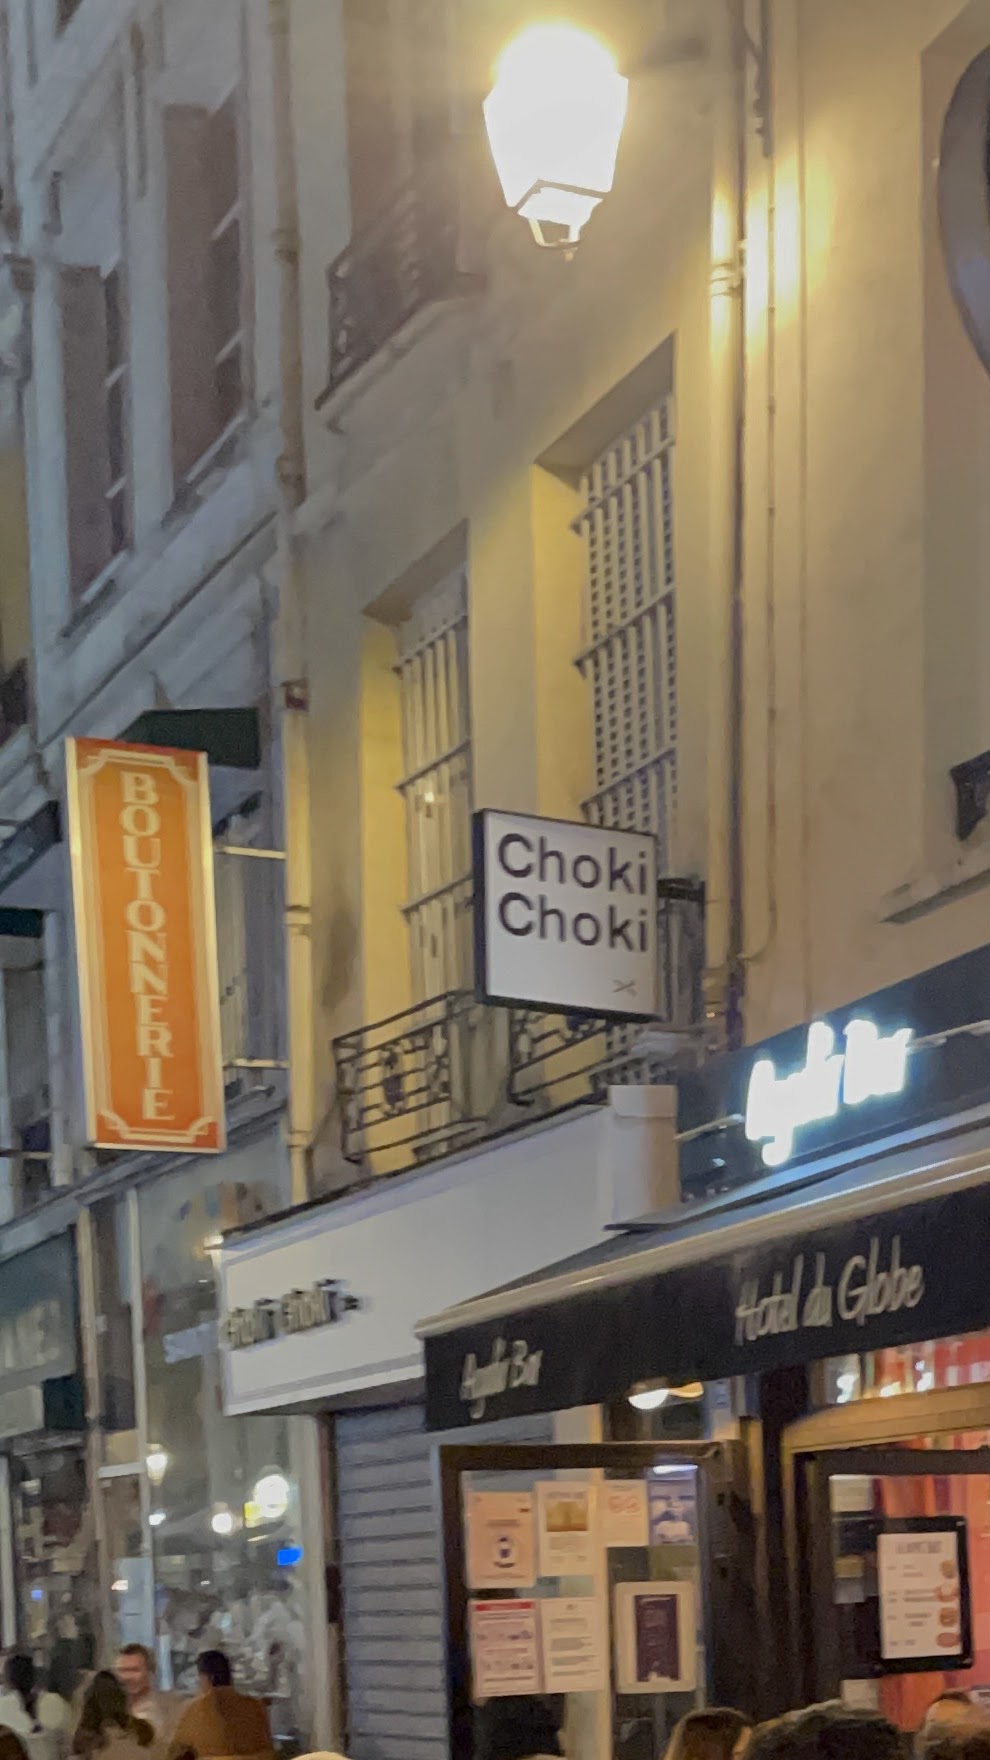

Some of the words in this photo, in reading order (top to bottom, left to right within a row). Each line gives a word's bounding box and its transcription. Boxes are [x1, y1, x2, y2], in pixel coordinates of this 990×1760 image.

[498, 832, 646, 895] Choki
[117, 769, 177, 1121] BOUTONNERIE
[499, 891, 647, 952] Choki
[837, 1234, 926, 1327] Globe
